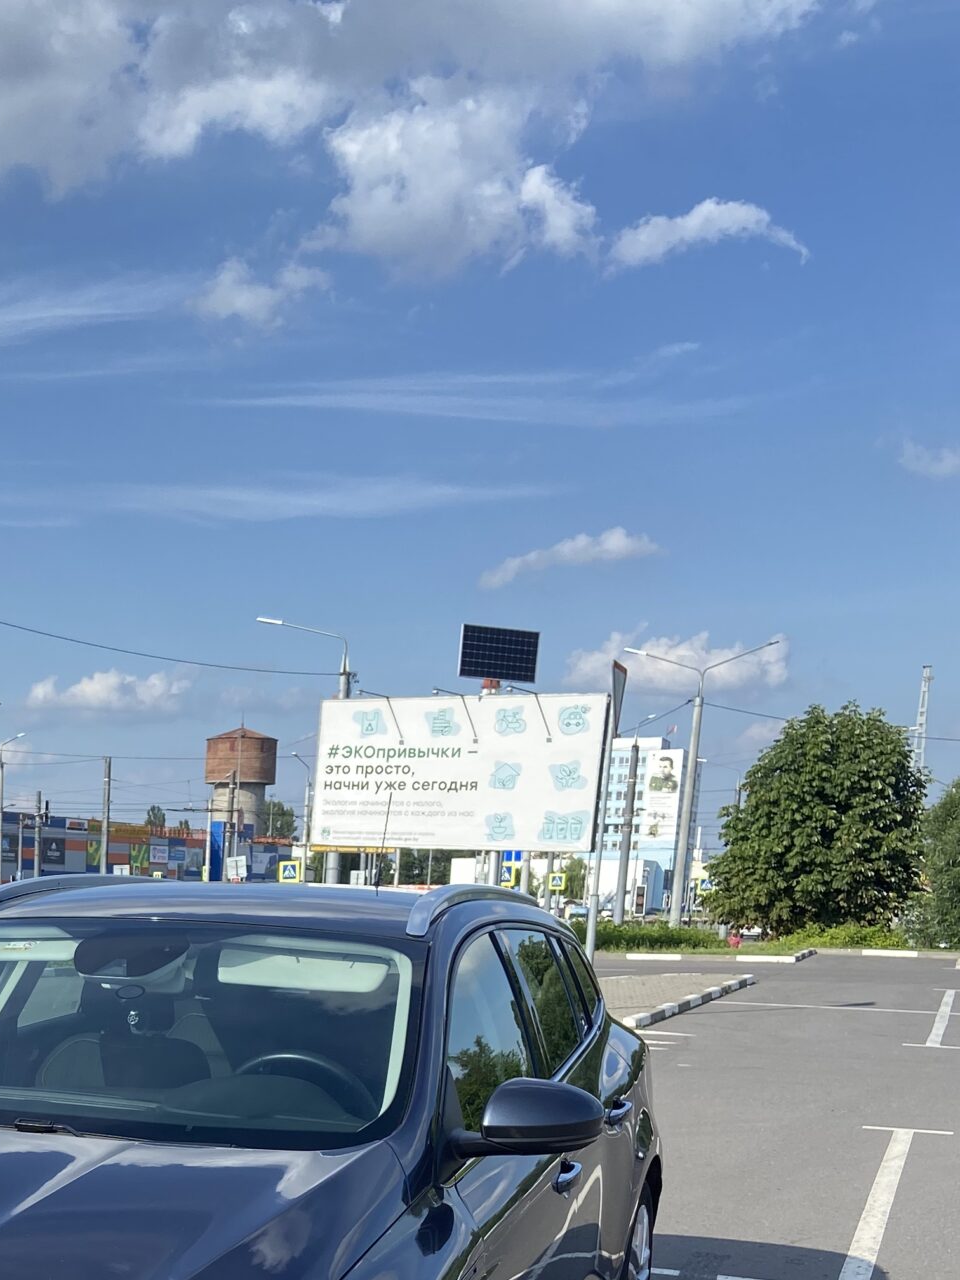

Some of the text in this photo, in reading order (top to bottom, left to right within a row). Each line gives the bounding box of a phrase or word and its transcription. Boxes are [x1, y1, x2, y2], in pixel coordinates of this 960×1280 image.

[327, 744, 462, 762] #ЭКОпривычки
[325, 764, 415, 778] это просто,
[324, 781, 478, 794] начни уже сегодня
